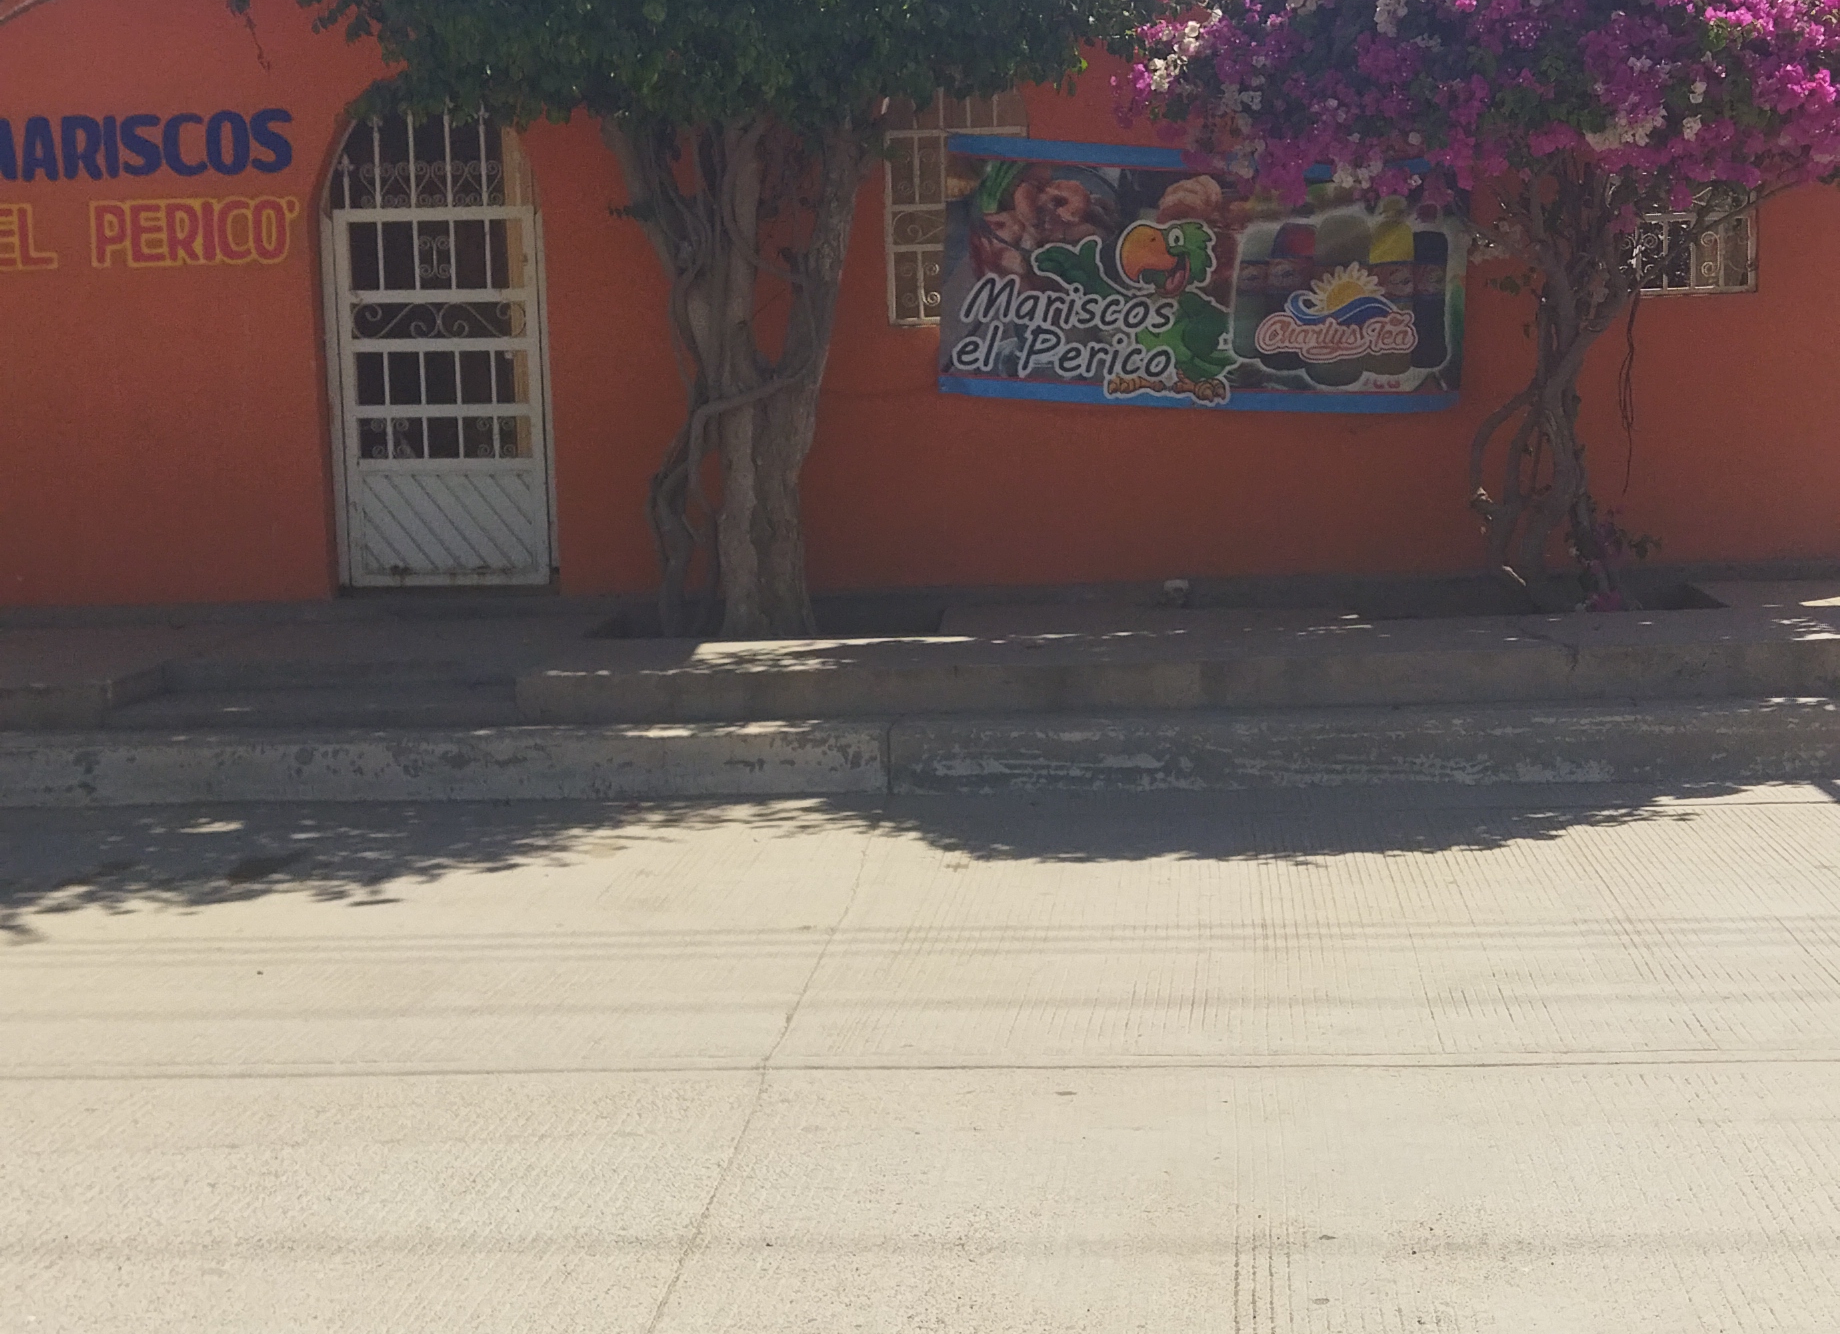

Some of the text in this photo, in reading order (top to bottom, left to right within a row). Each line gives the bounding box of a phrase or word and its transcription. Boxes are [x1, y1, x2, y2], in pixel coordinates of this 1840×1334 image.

[960, 273, 1177, 331] Mariscos
[953, 322, 1175, 379] el Perico
[1364, 318, 1411, 347] Tea
